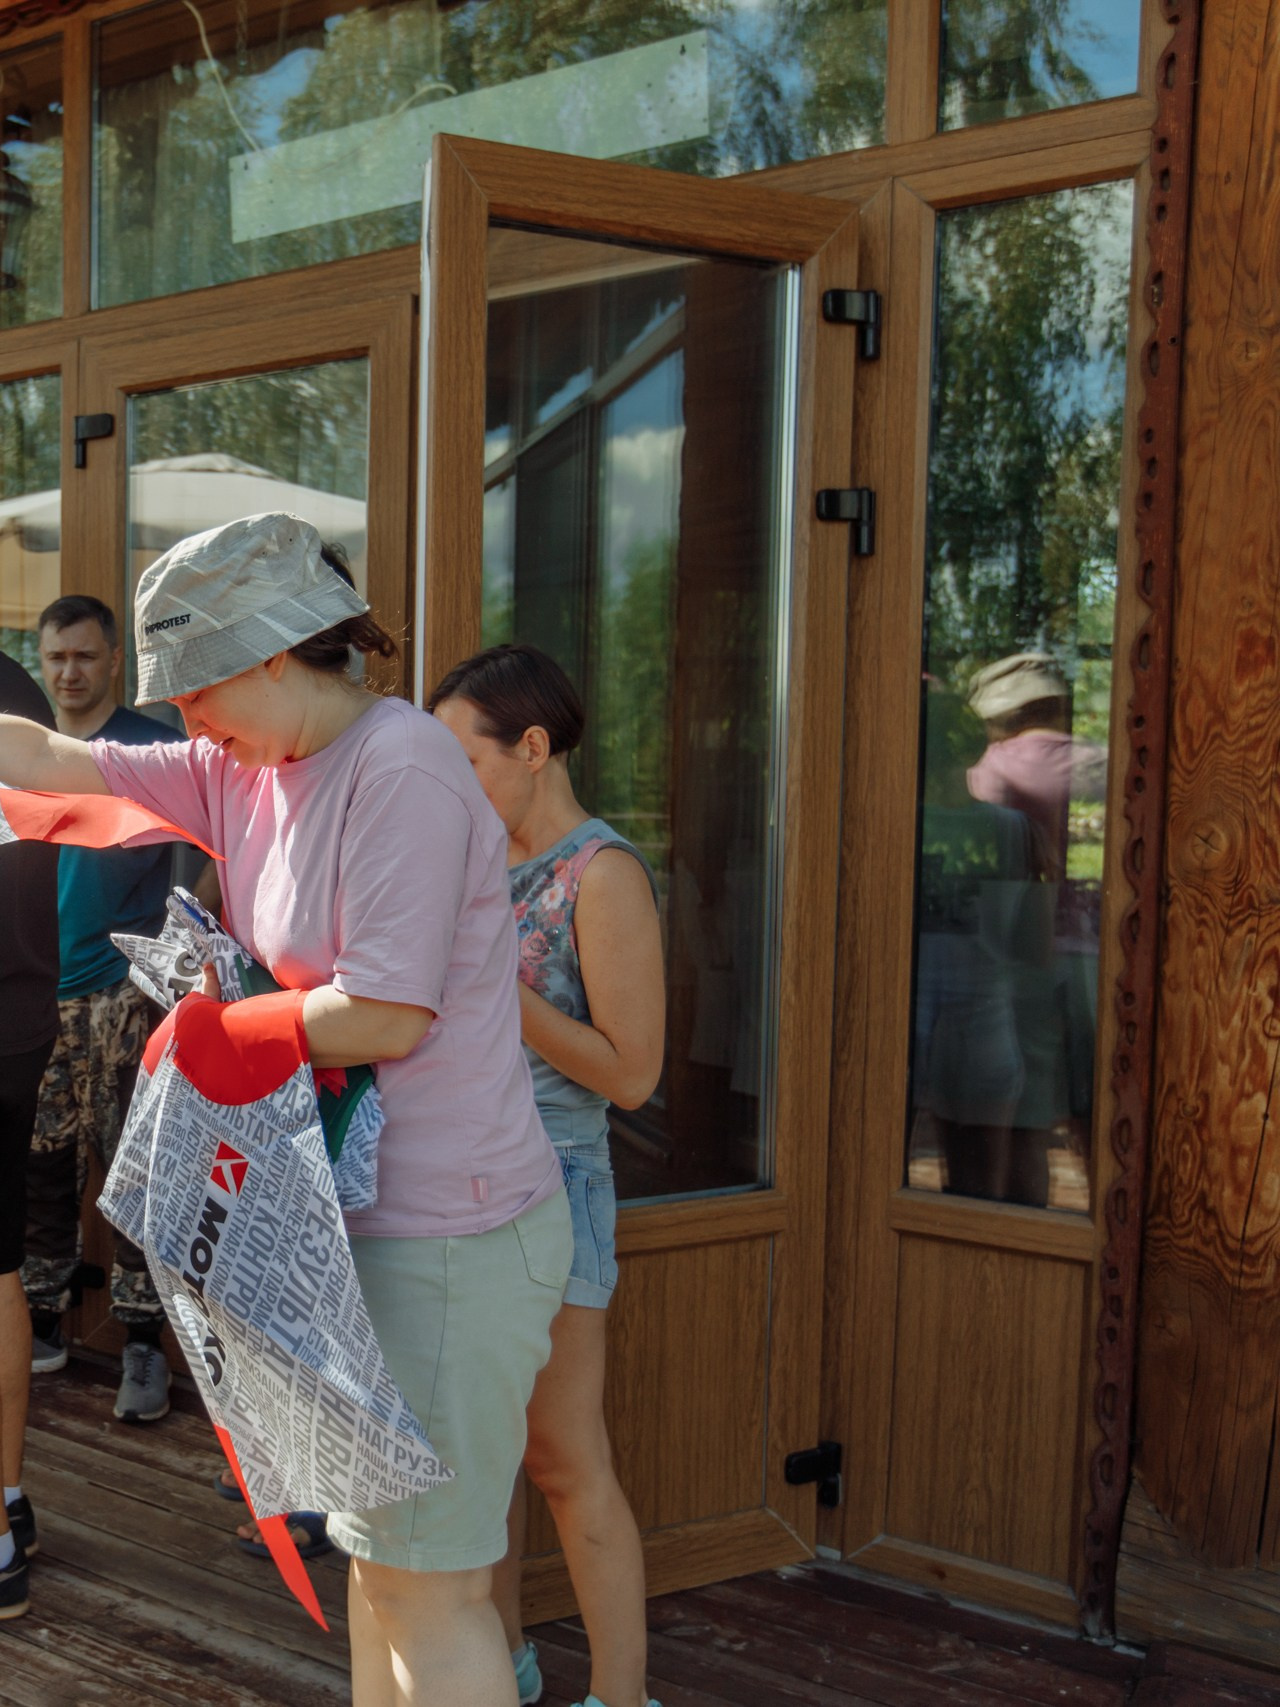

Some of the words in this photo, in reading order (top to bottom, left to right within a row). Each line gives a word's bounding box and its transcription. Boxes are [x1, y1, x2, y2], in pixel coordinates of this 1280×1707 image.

[166, 1119, 204, 1226] ИСПЫТАНИЯ
[185, 1097, 234, 1141] ОПТИМАЛЬНОЕ
[232, 1133, 269, 1168] РЕШЕНИЕ
[259, 1134, 293, 1208] ЗАПУСК
[175, 1129, 220, 1237] РАЗРАБОТКА
[221, 1166, 264, 1259] ПРОЕКТНАЯ
[271, 1154, 319, 1271] ТЕХНИЧЕСКИЕ
[223, 1206, 282, 1346] КОНТРОЛЬ
[246, 1266, 284, 1365] ПАРАМЕТРЫ
[263, 1188, 340, 1392] РЕЗУЛЬТАТ
[297, 1344, 369, 1413] ПУСКОНАЛАДКА
[306, 1326, 361, 1386] СТАНЦИИ
[314, 1307, 366, 1366] НАСОСНЫЕ
[356, 1441, 389, 1474] НАШИ
